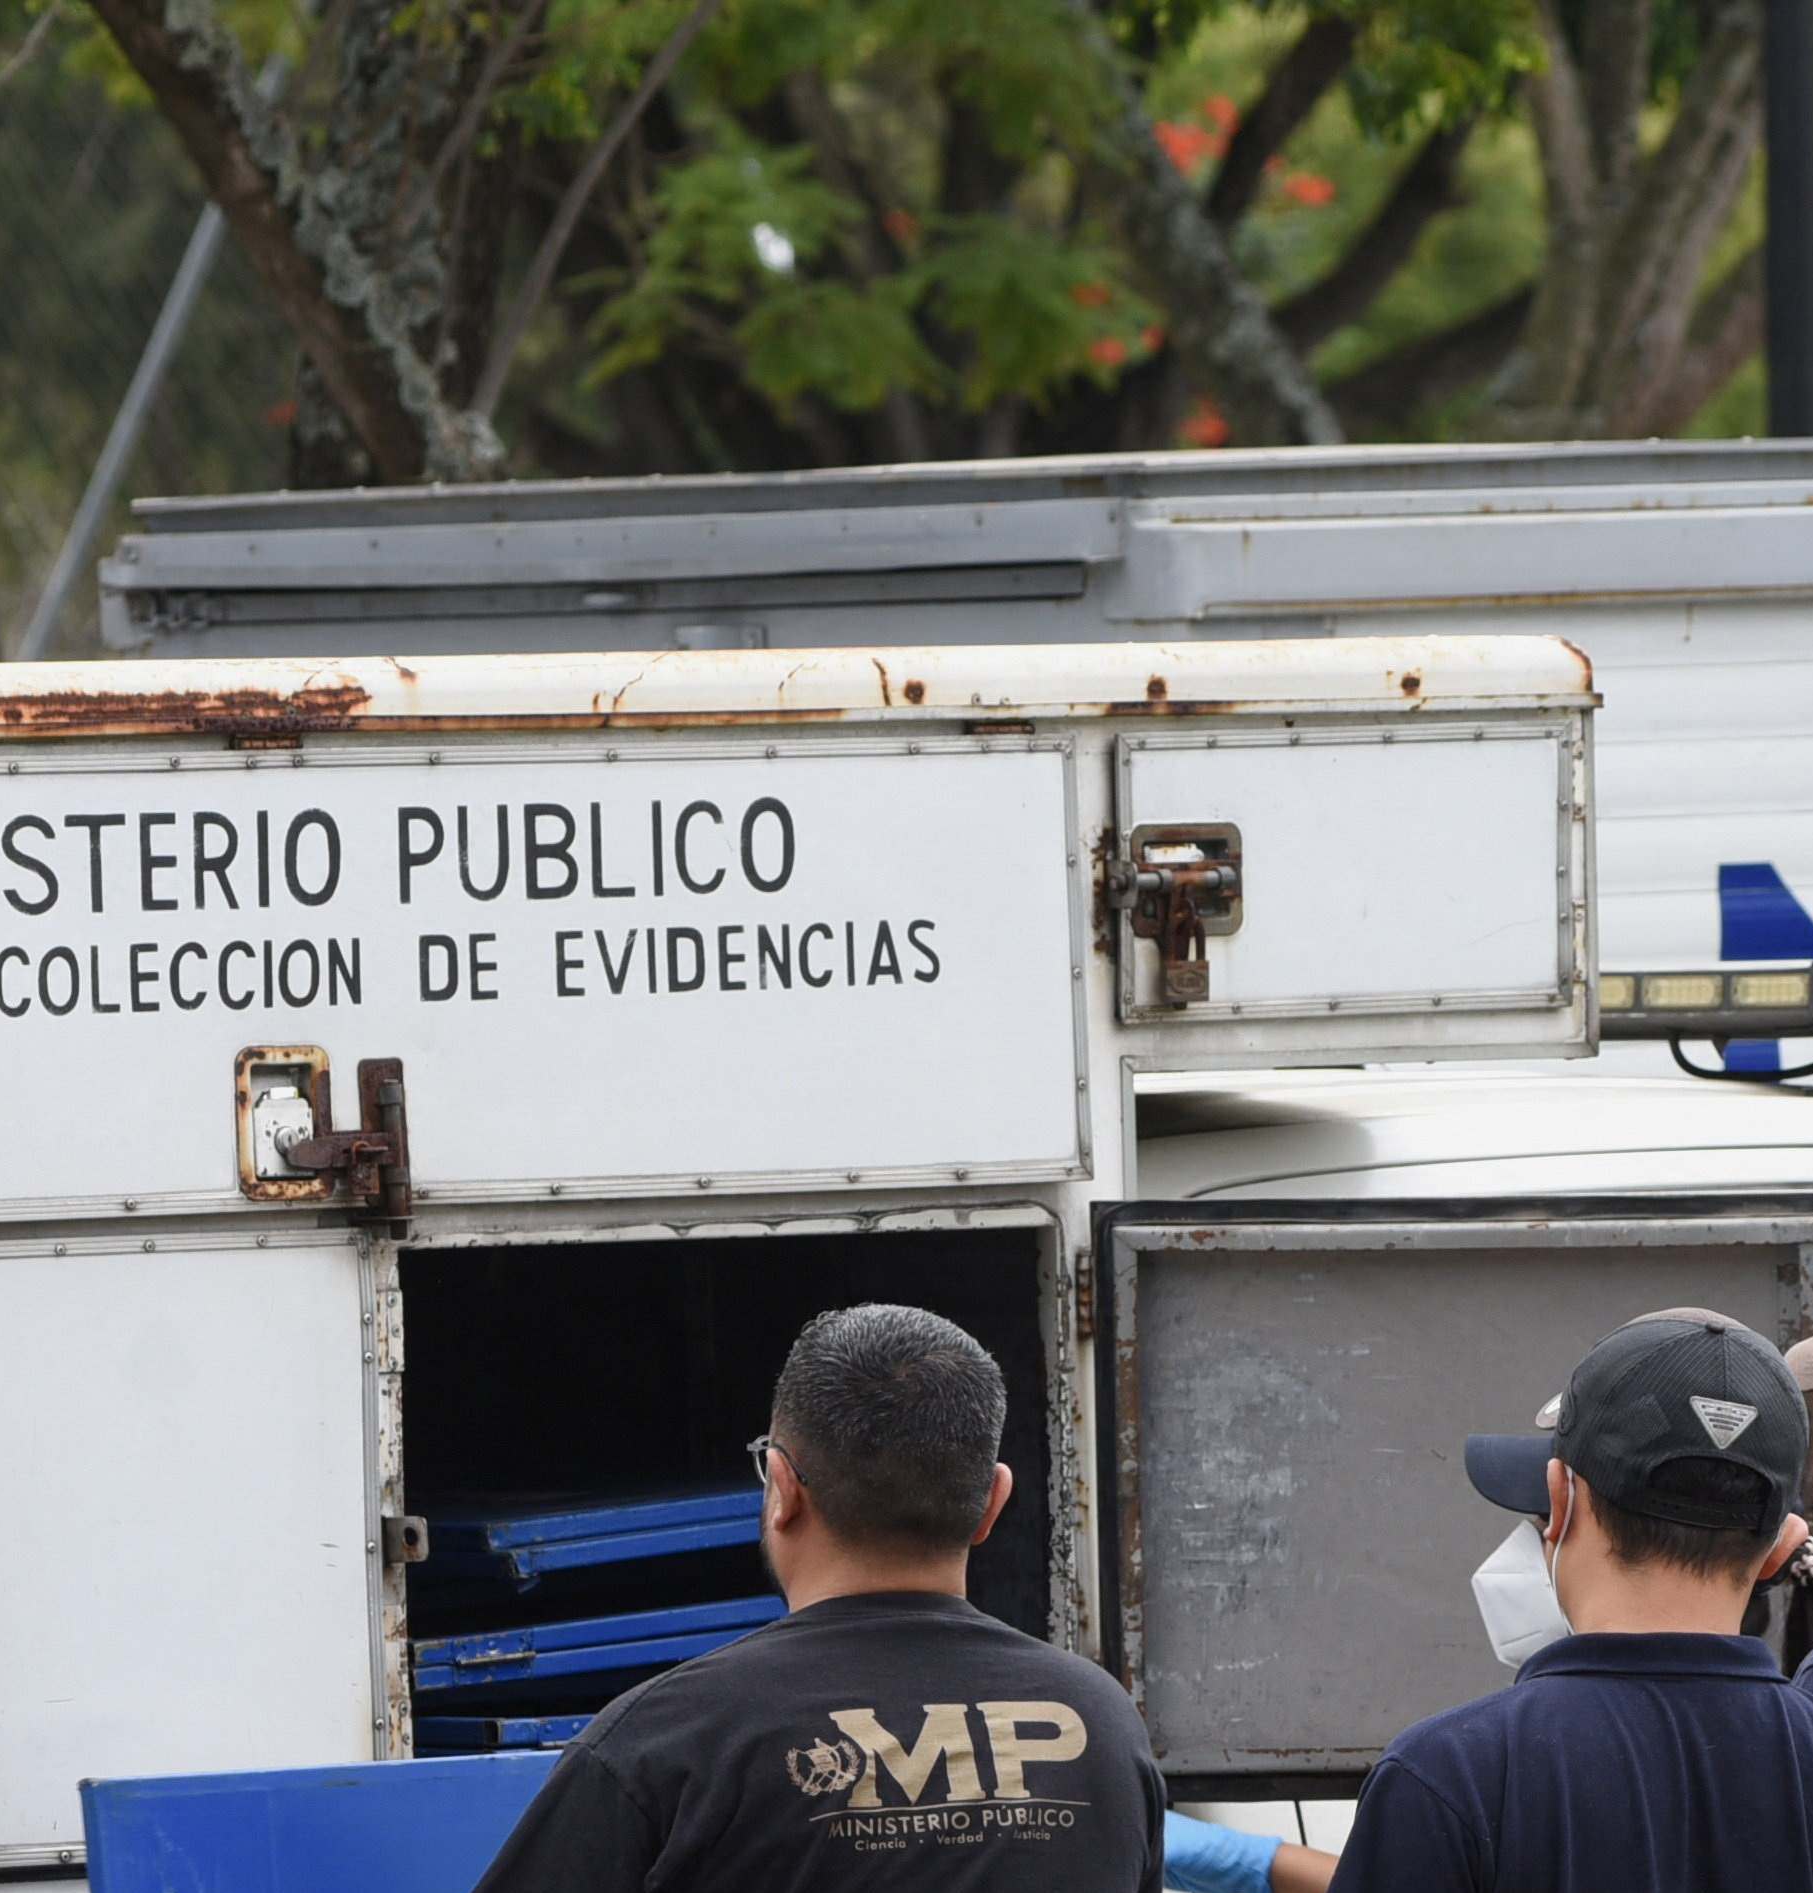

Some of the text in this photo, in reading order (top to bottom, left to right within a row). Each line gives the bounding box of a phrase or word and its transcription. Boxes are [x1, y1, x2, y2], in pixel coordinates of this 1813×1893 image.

[396, 795, 796, 905] PUBLICO
[418, 931, 500, 1003] DE
[553, 919, 942, 997] EVIDENCIAS
[828, 1700, 1088, 1808] MP
[828, 1804, 1076, 1840] MINISTERIO PÚBLICO
[854, 1838, 907, 1852] Ciencia
[936, 1831, 985, 1847] Verdad
